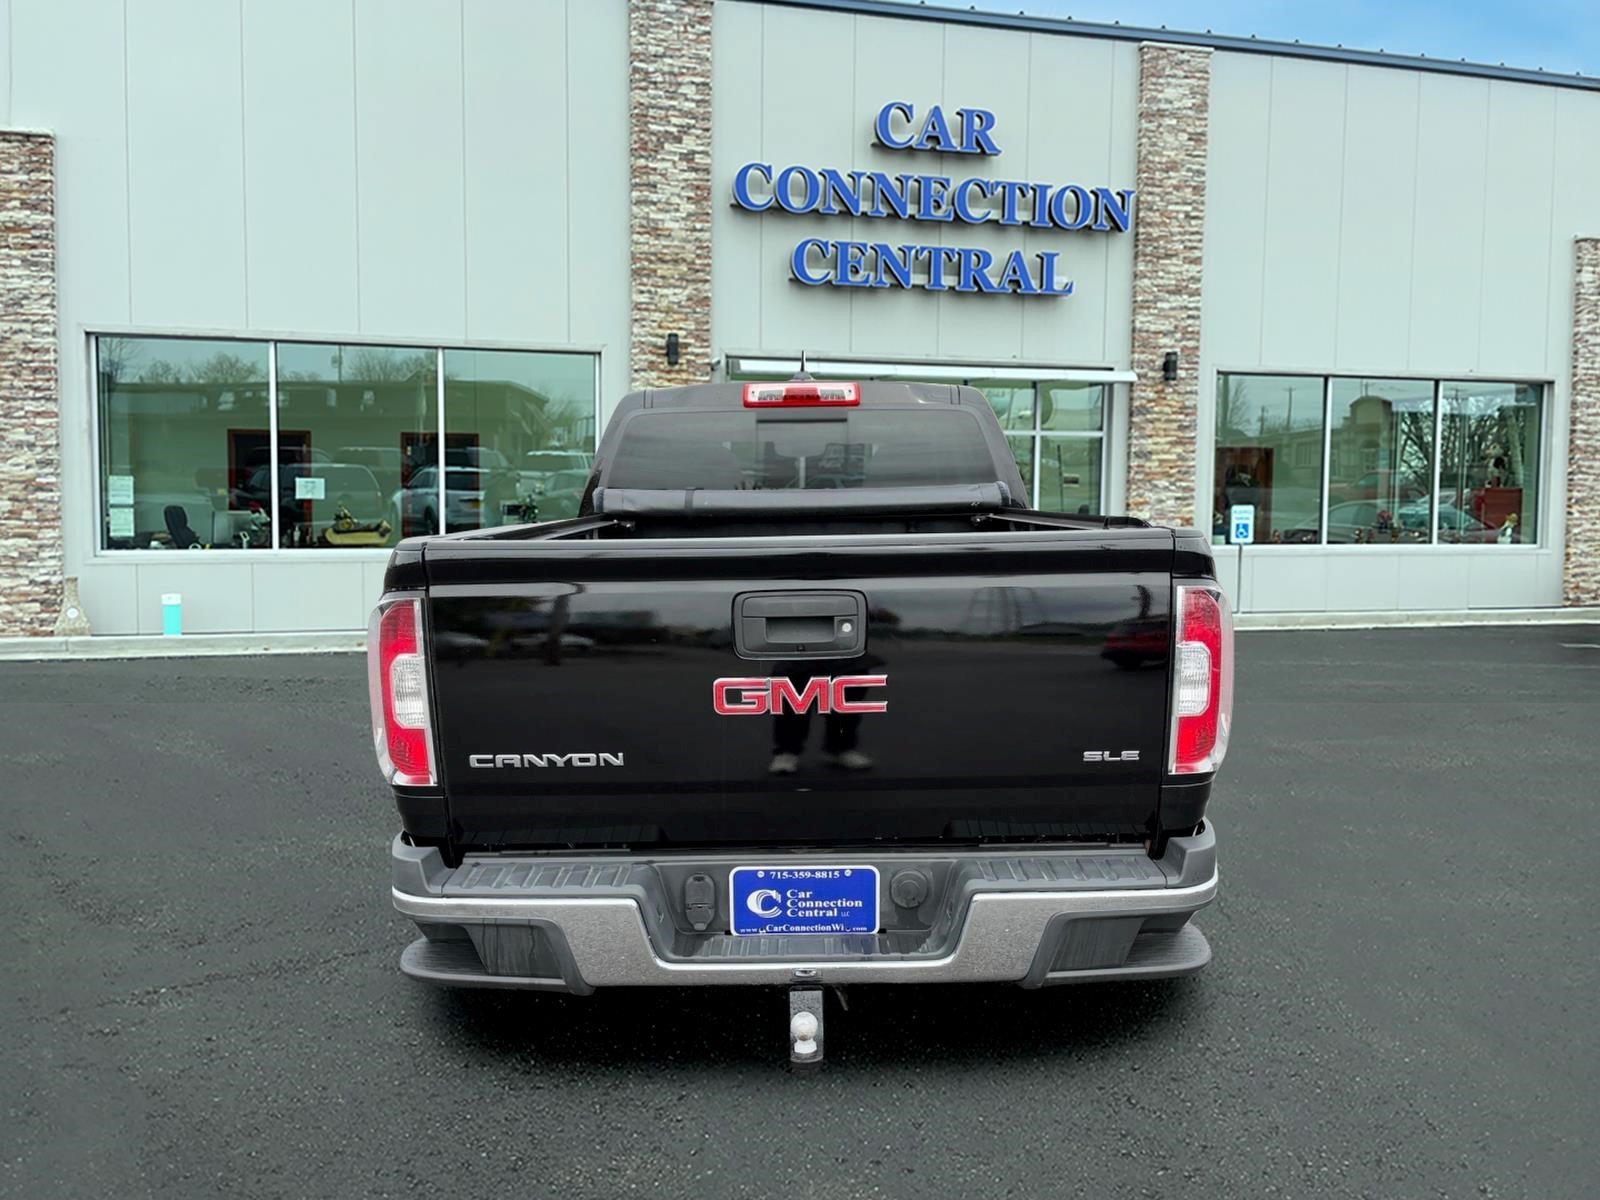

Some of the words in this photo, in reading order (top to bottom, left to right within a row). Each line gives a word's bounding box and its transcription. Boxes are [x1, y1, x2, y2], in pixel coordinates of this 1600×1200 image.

[875, 101, 1002, 156] CAR
[733, 160, 1135, 233] CONNECTION
[791, 238, 1074, 297] CENTRAL
[712, 674, 889, 716] GMC
[469, 752, 625, 769] CANYON
[1082, 750, 1140, 762] SLE
[770, 870, 840, 880] 715-359-8815
[786, 889, 813, 899] Car
[786, 898, 863, 908] Connection
[786, 908, 838, 918] Central
